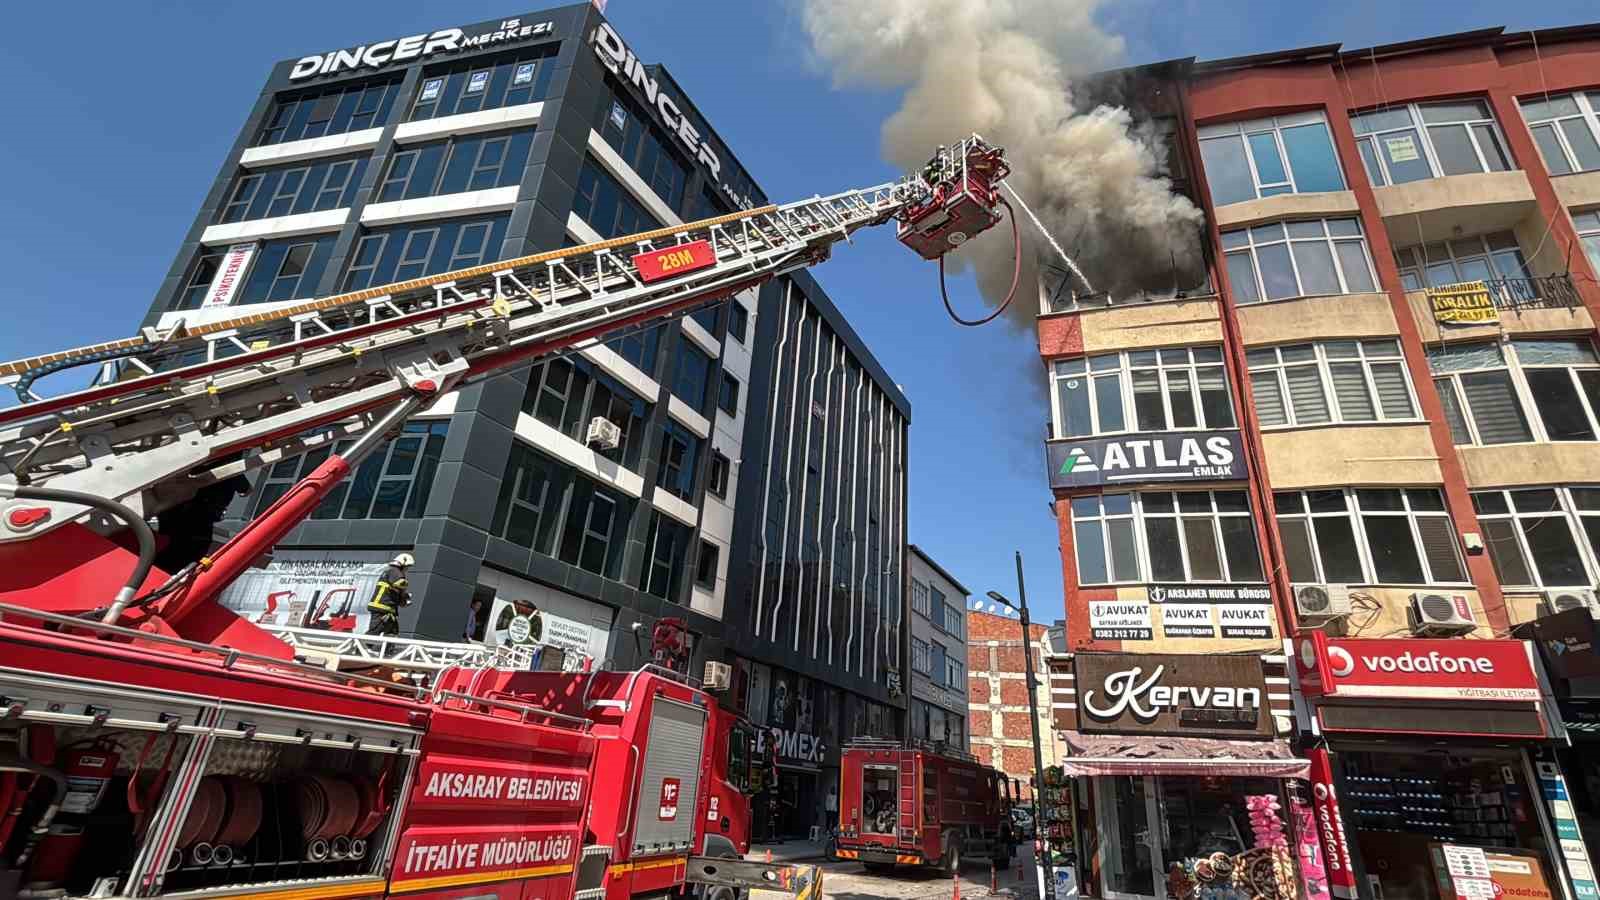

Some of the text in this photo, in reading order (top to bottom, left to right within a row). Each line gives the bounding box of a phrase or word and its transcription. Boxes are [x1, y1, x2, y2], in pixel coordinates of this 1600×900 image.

[657, 249, 694, 272] 28M
[1102, 436, 1234, 471] ATLAS
[1193, 465, 1232, 477] EMLAK
[1168, 588, 1271, 599] ARSLANER HUKUK BÜROSU
[1106, 605, 1149, 616] AVUKAT
[1165, 609, 1209, 620] AVUKAT
[1221, 609, 1266, 620] AVUKAT
[1095, 630, 1113, 638] 0382
[1114, 630, 1127, 638] 212
[1128, 630, 1138, 638] 77
[1362, 651, 1494, 674] vodafone
[1084, 664, 1261, 719] Kervan
[424, 773, 583, 801] AKSARAY BELEDİYESİ
[1319, 804, 1341, 871] vodafone
[404, 835, 572, 873] İTFAİYE MÜDÜRLÜĞÜ
